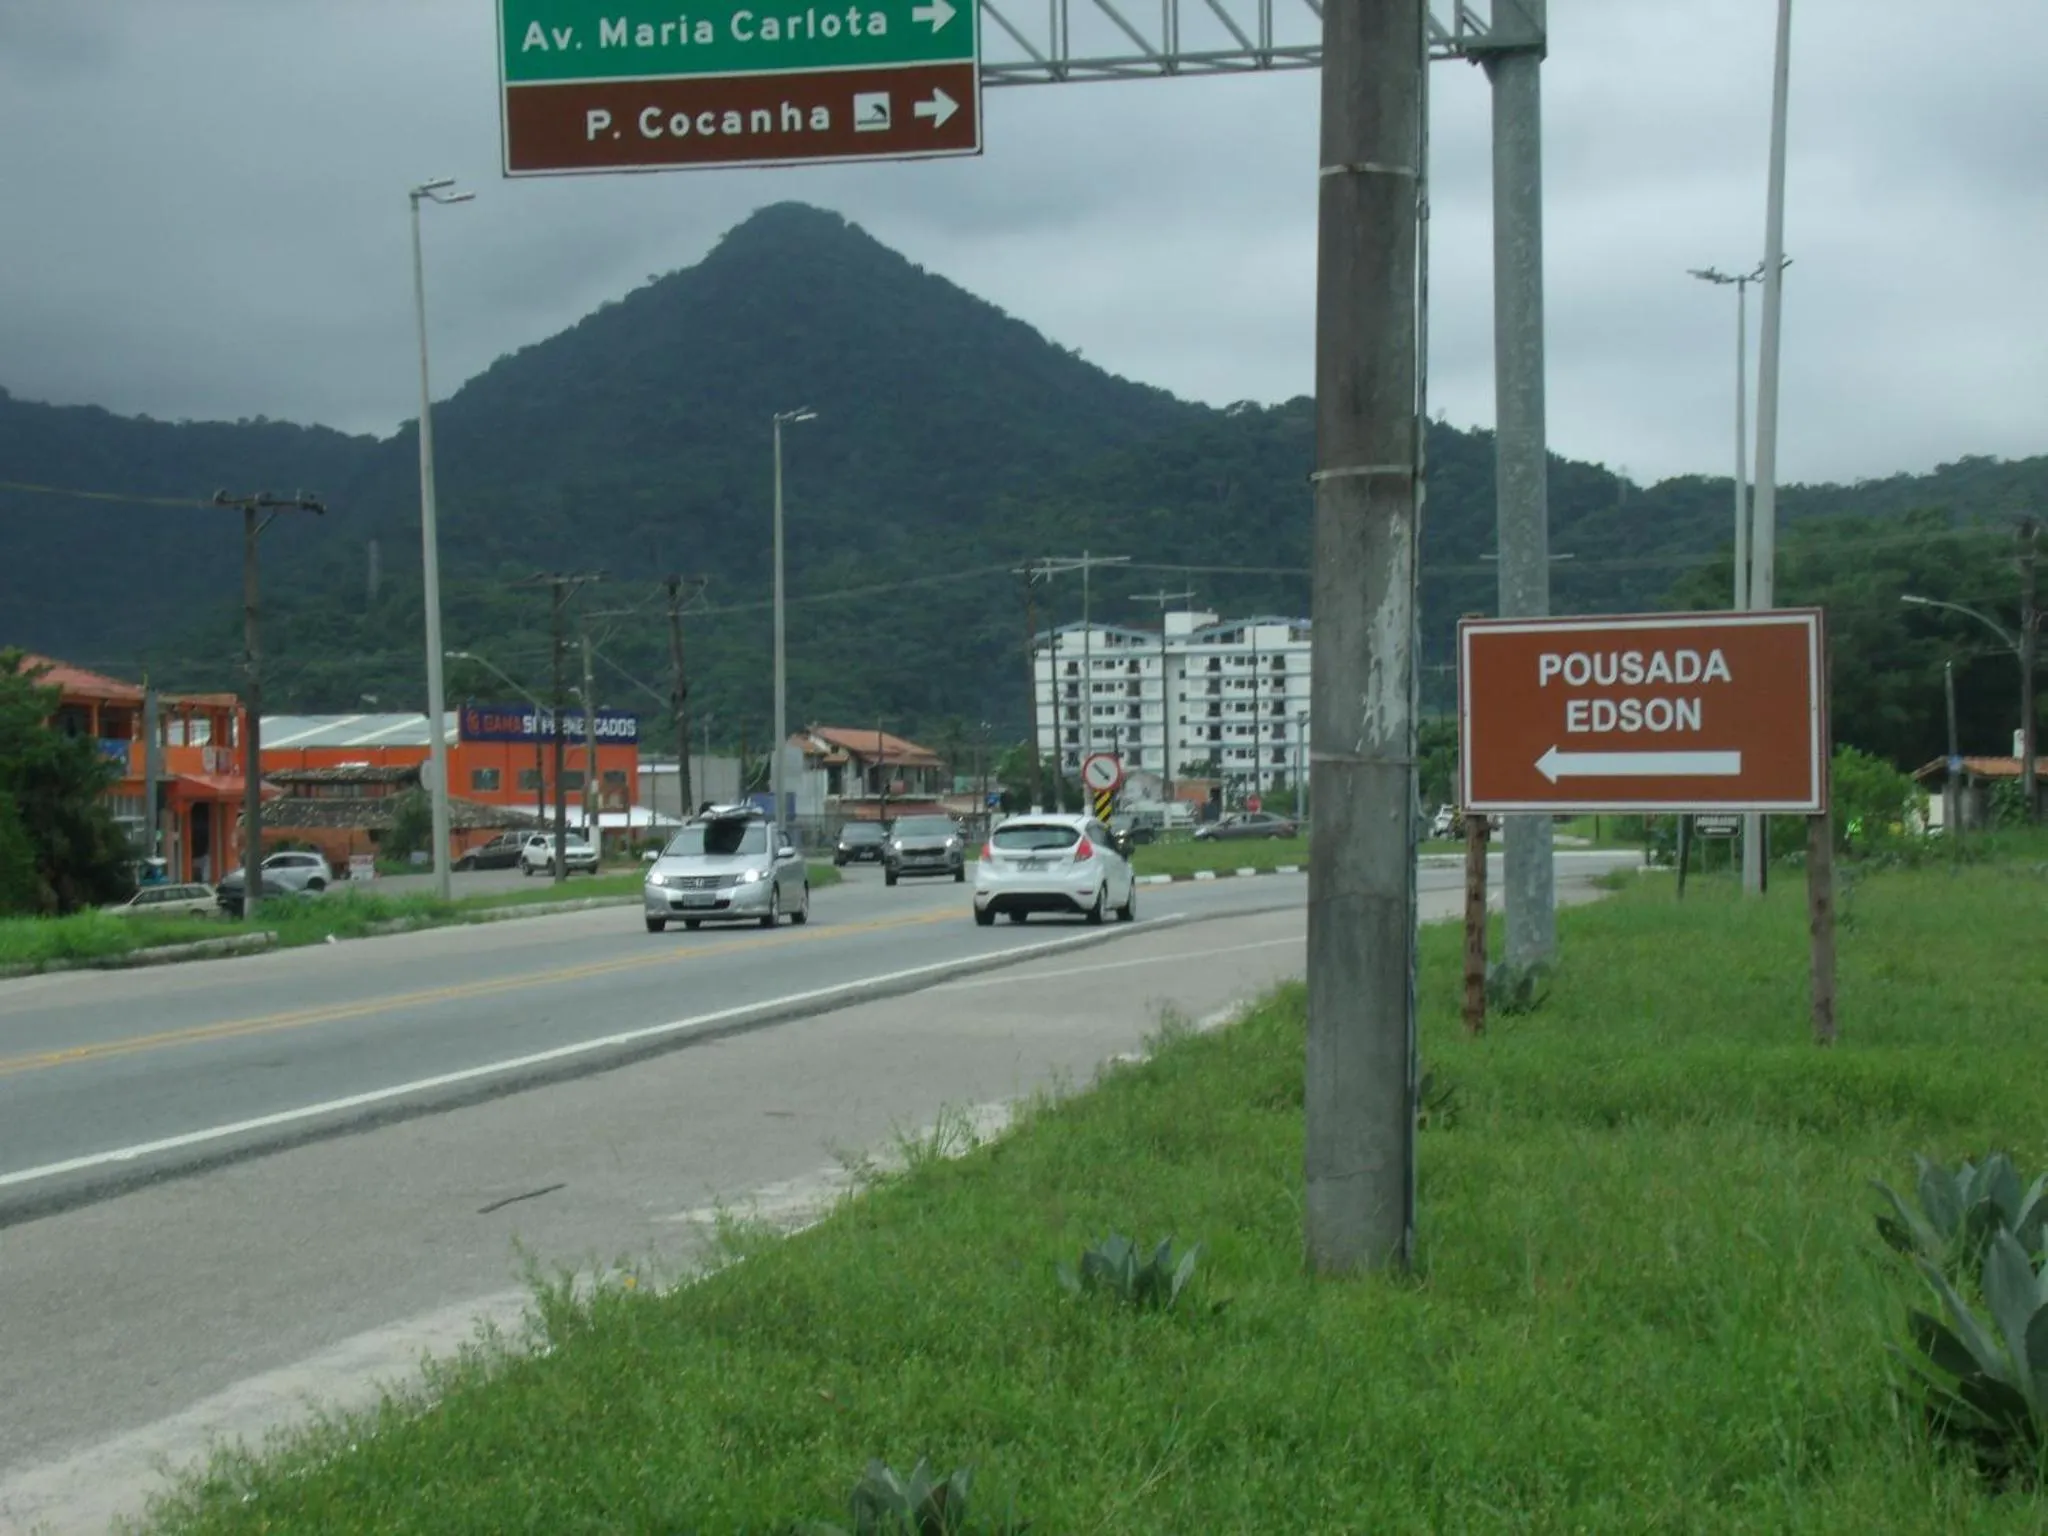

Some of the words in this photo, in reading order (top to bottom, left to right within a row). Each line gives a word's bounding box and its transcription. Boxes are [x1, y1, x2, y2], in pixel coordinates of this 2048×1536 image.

[522, 21, 582, 52] Av.
[600, 15, 714, 48] Maria
[731, 6, 887, 42] Carlota
[586, 109, 621, 141] P.
[638, 101, 831, 139] Cocanha
[1538, 649, 1732, 687] POUSADA
[1566, 697, 1701, 733] EDSON
